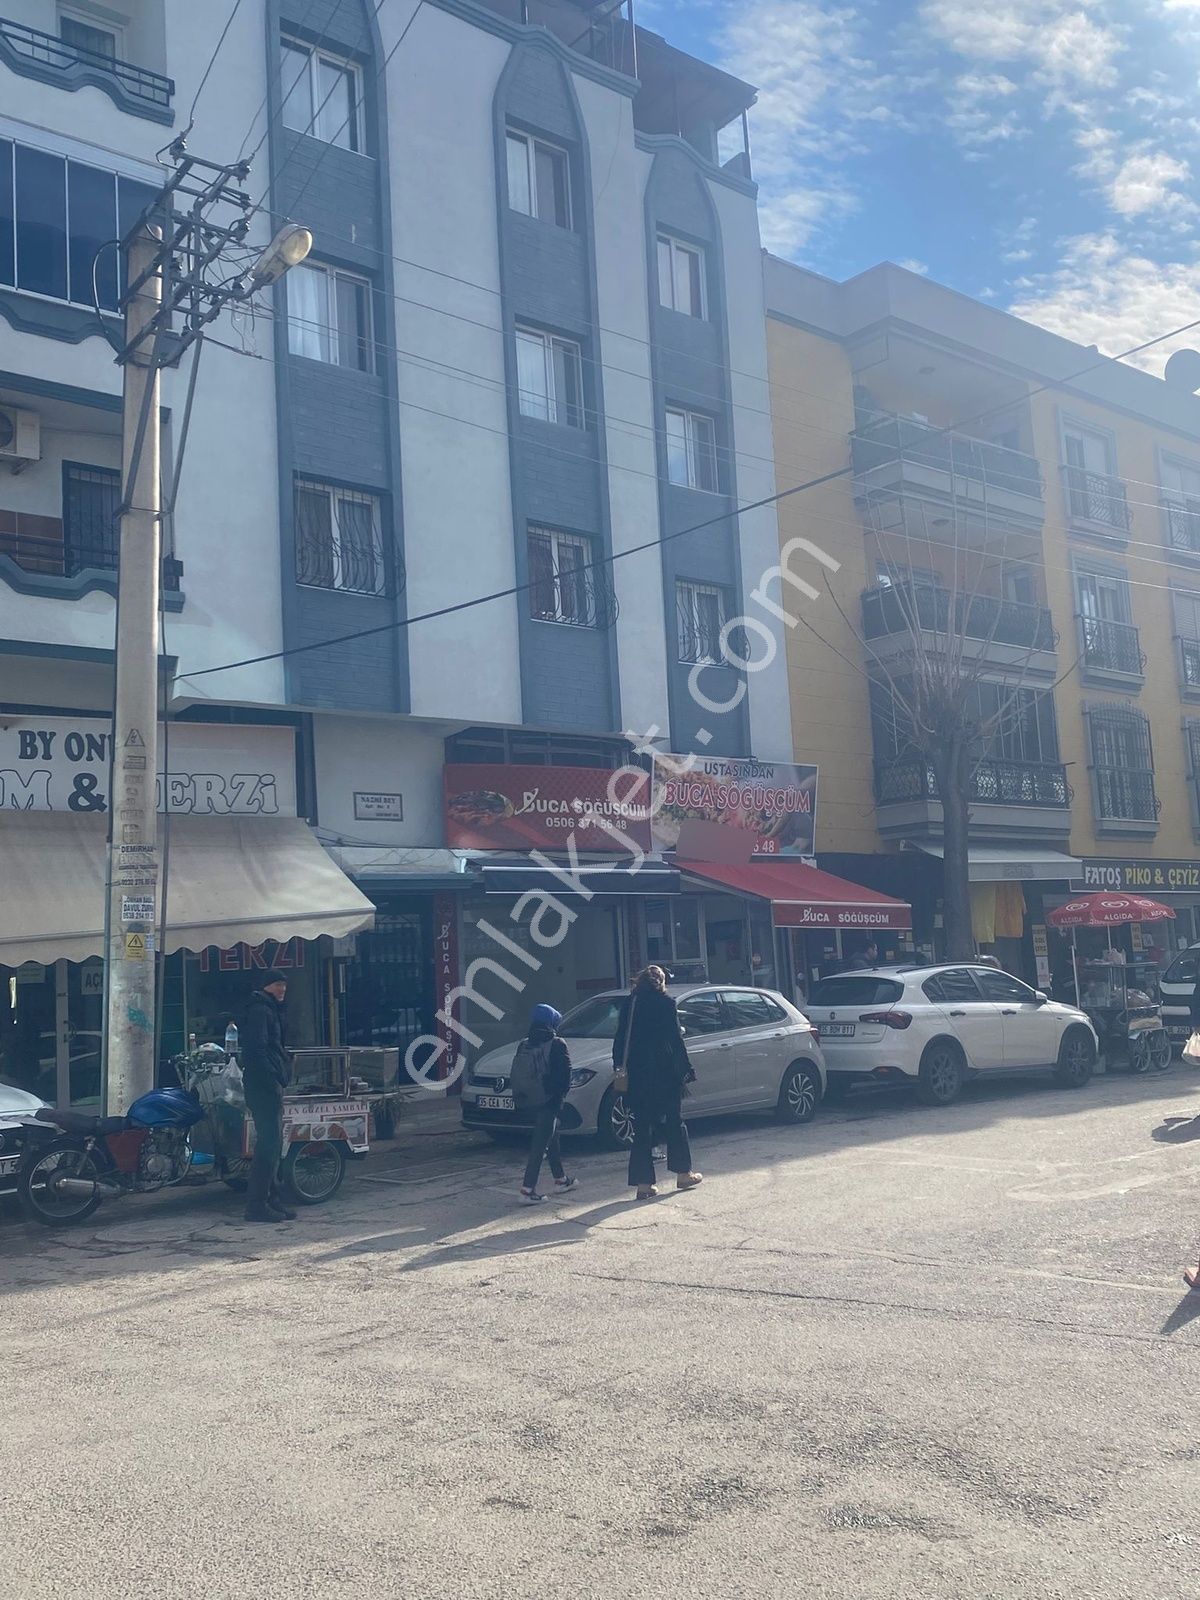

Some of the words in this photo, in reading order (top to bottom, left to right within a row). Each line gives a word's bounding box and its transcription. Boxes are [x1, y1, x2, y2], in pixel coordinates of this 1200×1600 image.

[18, 730, 56, 760] BY
[64, 731, 114, 762] ON
[704, 762, 774, 779] USTASINDAN
[68, 772, 108, 812] &
[156, 772, 279, 814] ERZi
[514, 788, 570, 816] BUCA
[664, 777, 715, 808] BUCA
[546, 816, 575, 828] 0506
[600, 819, 613, 830] 56
[615, 819, 627, 831] 48
[762, 840, 775, 853] 48
[1084, 866, 1121, 890] FATOŞ
[1125, 864, 1152, 885] PİKO
[1154, 868, 1165, 885] &
[1168, 864, 1200, 890] ÇEYİZ
[800, 907, 830, 923] BUCA
[1104, 912, 1133, 921] ALGIDA
